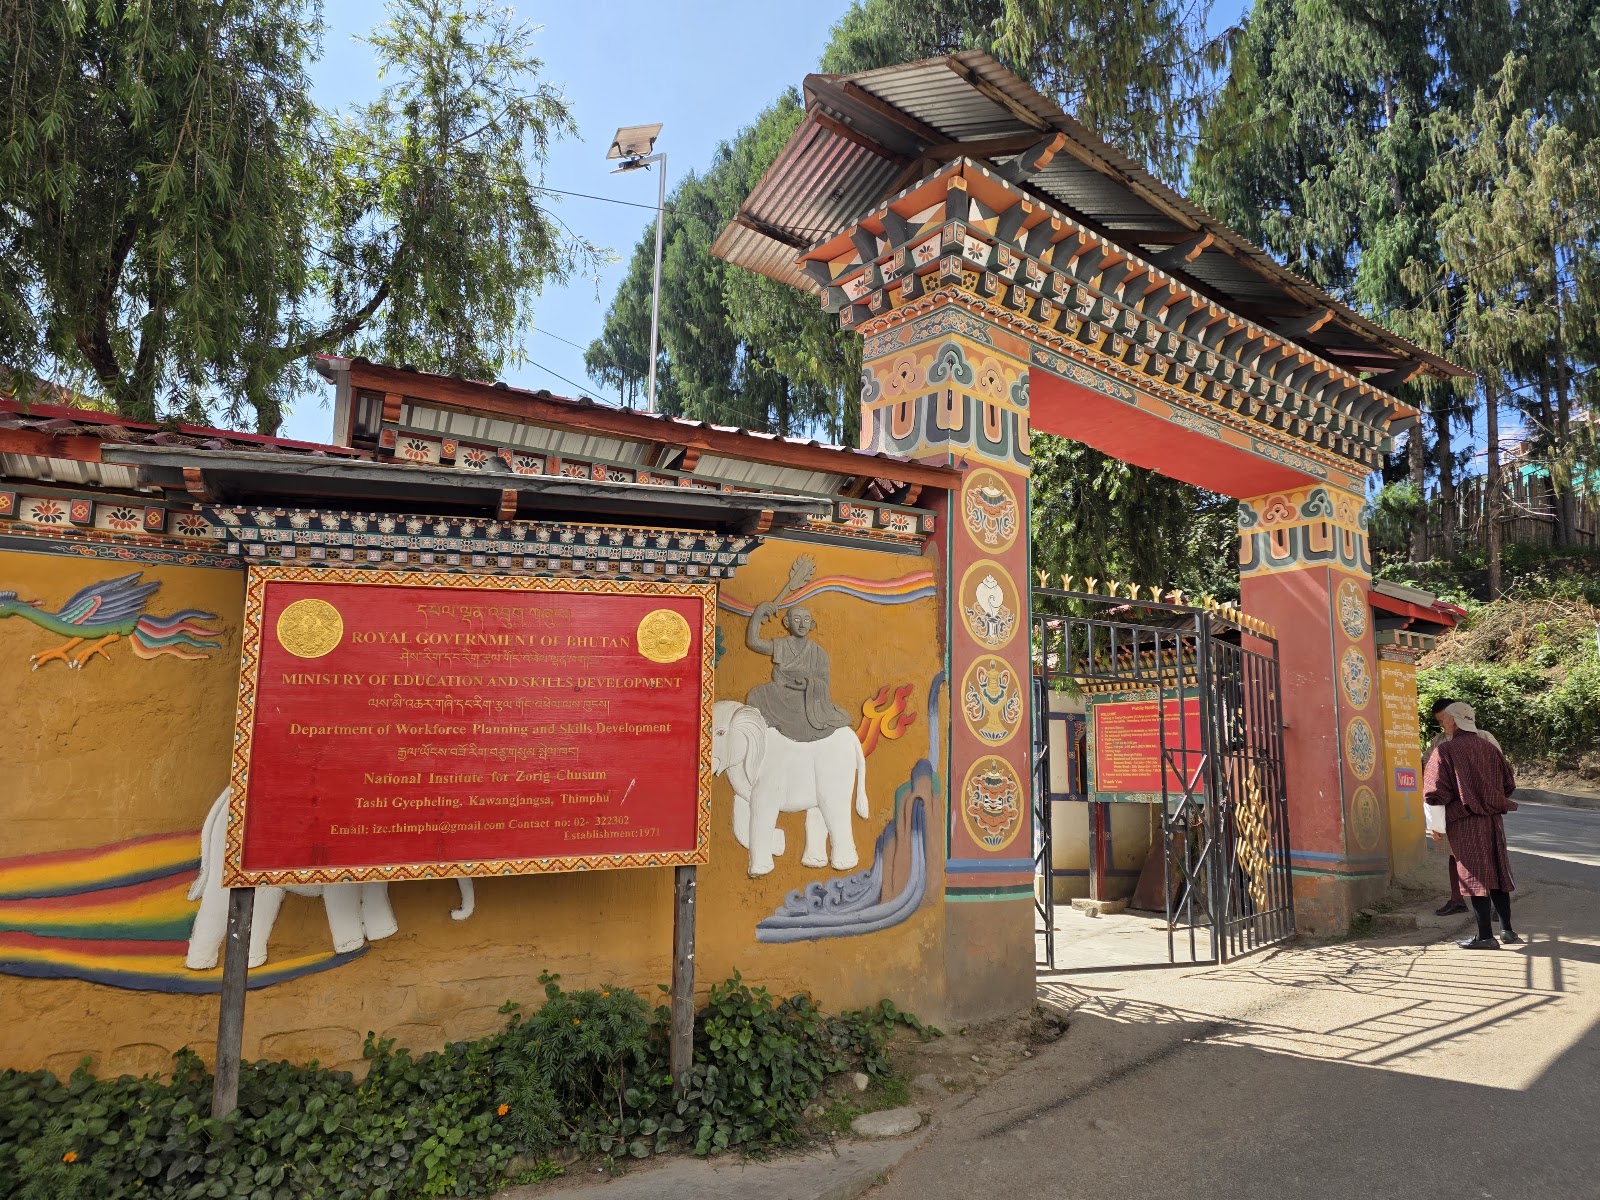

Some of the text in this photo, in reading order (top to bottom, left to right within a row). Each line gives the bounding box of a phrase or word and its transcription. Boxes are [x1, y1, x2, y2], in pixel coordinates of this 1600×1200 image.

[352, 631, 630, 648] ROYAL GOVERNMENT OF BHUTAN
[282, 673, 682, 688] MINISTRY OF EDUCATION AND SKILLS DEVELOPMENT
[289, 722, 671, 737] Department of Workforce Planning and Skills Development
[363, 769, 607, 784] National Institute for Zorig Chusum
[1398, 773, 1415, 786] Notice
[355, 793, 610, 810] Tashi Gyepheling, Kawangjangsa, Thimphu
[330, 824, 369, 835] Email:
[373, 821, 505, 835] izc.thimphu@gmail.com
[509, 819, 550, 829] Contact
[554, 819, 571, 828] no:
[595, 816, 630, 826] 322302
